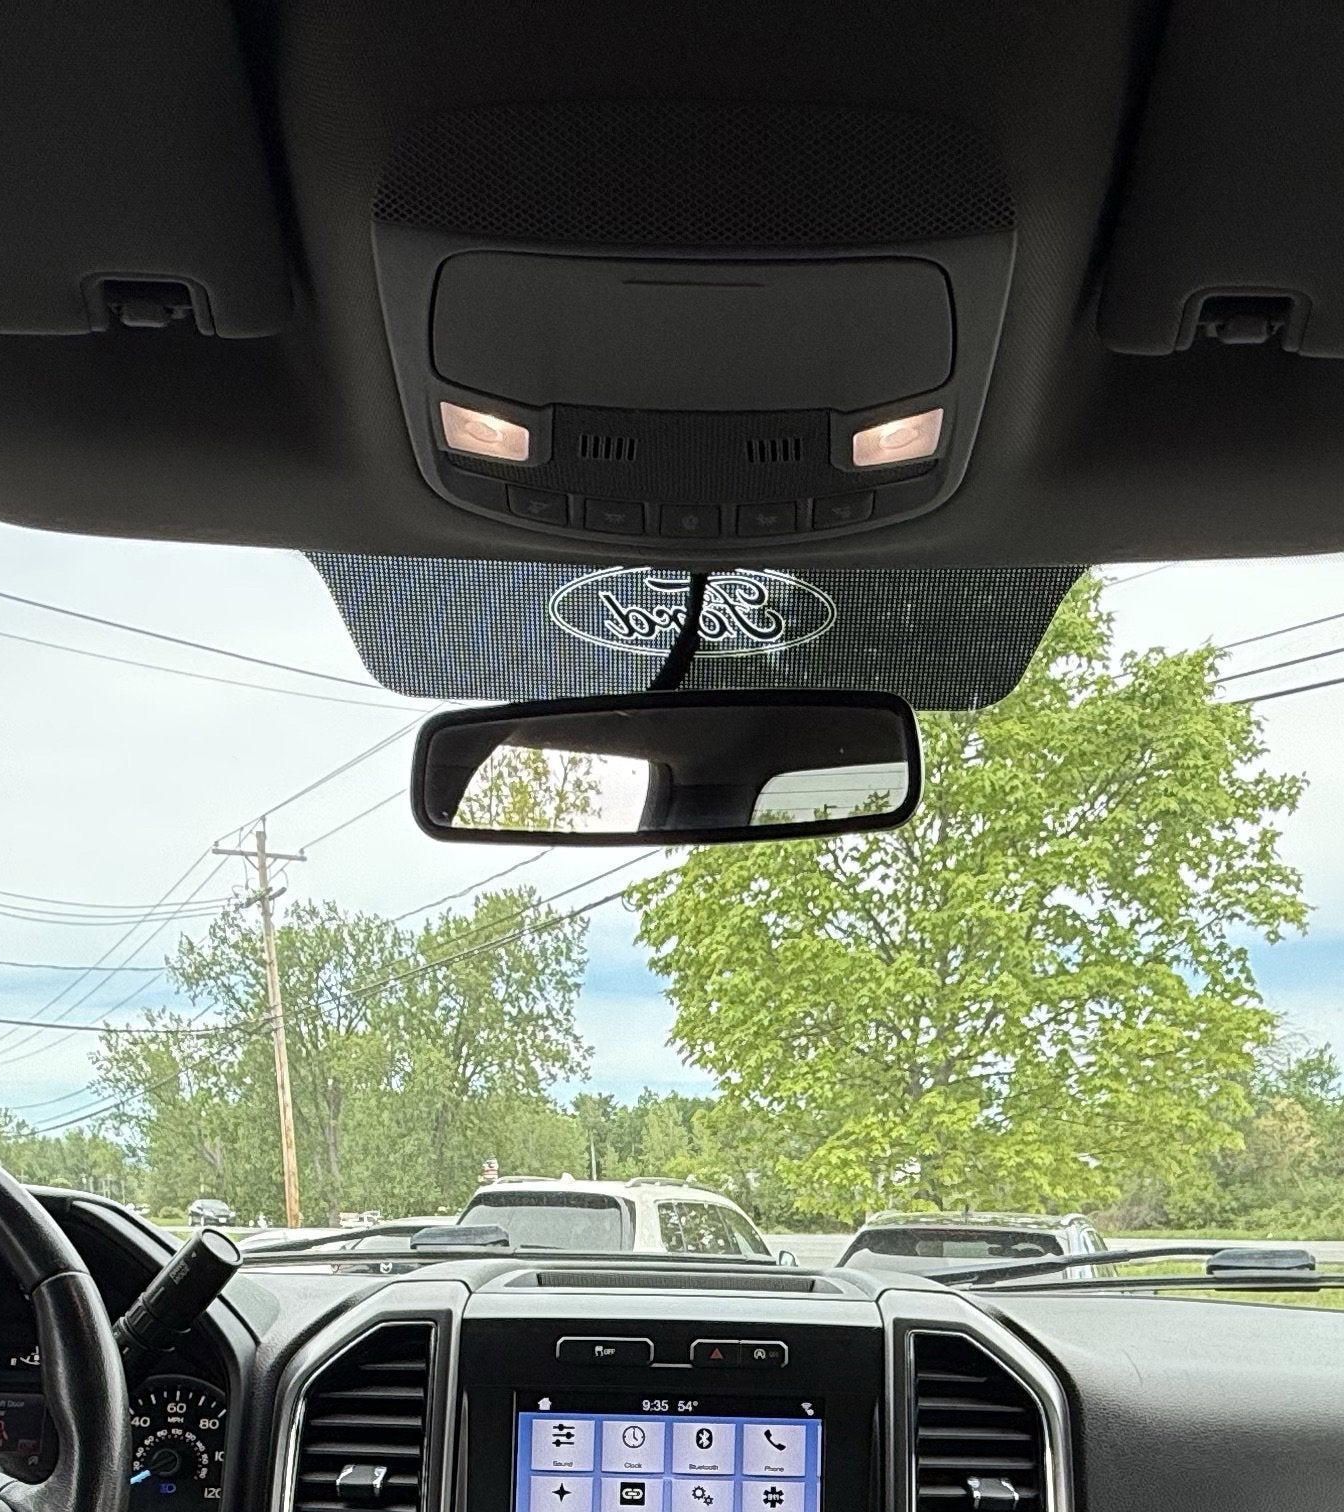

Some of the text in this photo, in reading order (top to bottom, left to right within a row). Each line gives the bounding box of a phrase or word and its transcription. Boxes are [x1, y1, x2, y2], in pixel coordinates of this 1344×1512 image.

[167, 1403, 187, 1413] 60
[642, 1399, 669, 1412] 9:35
[130, 1416, 150, 1427] 40
[199, 1418, 219, 1430] 80
